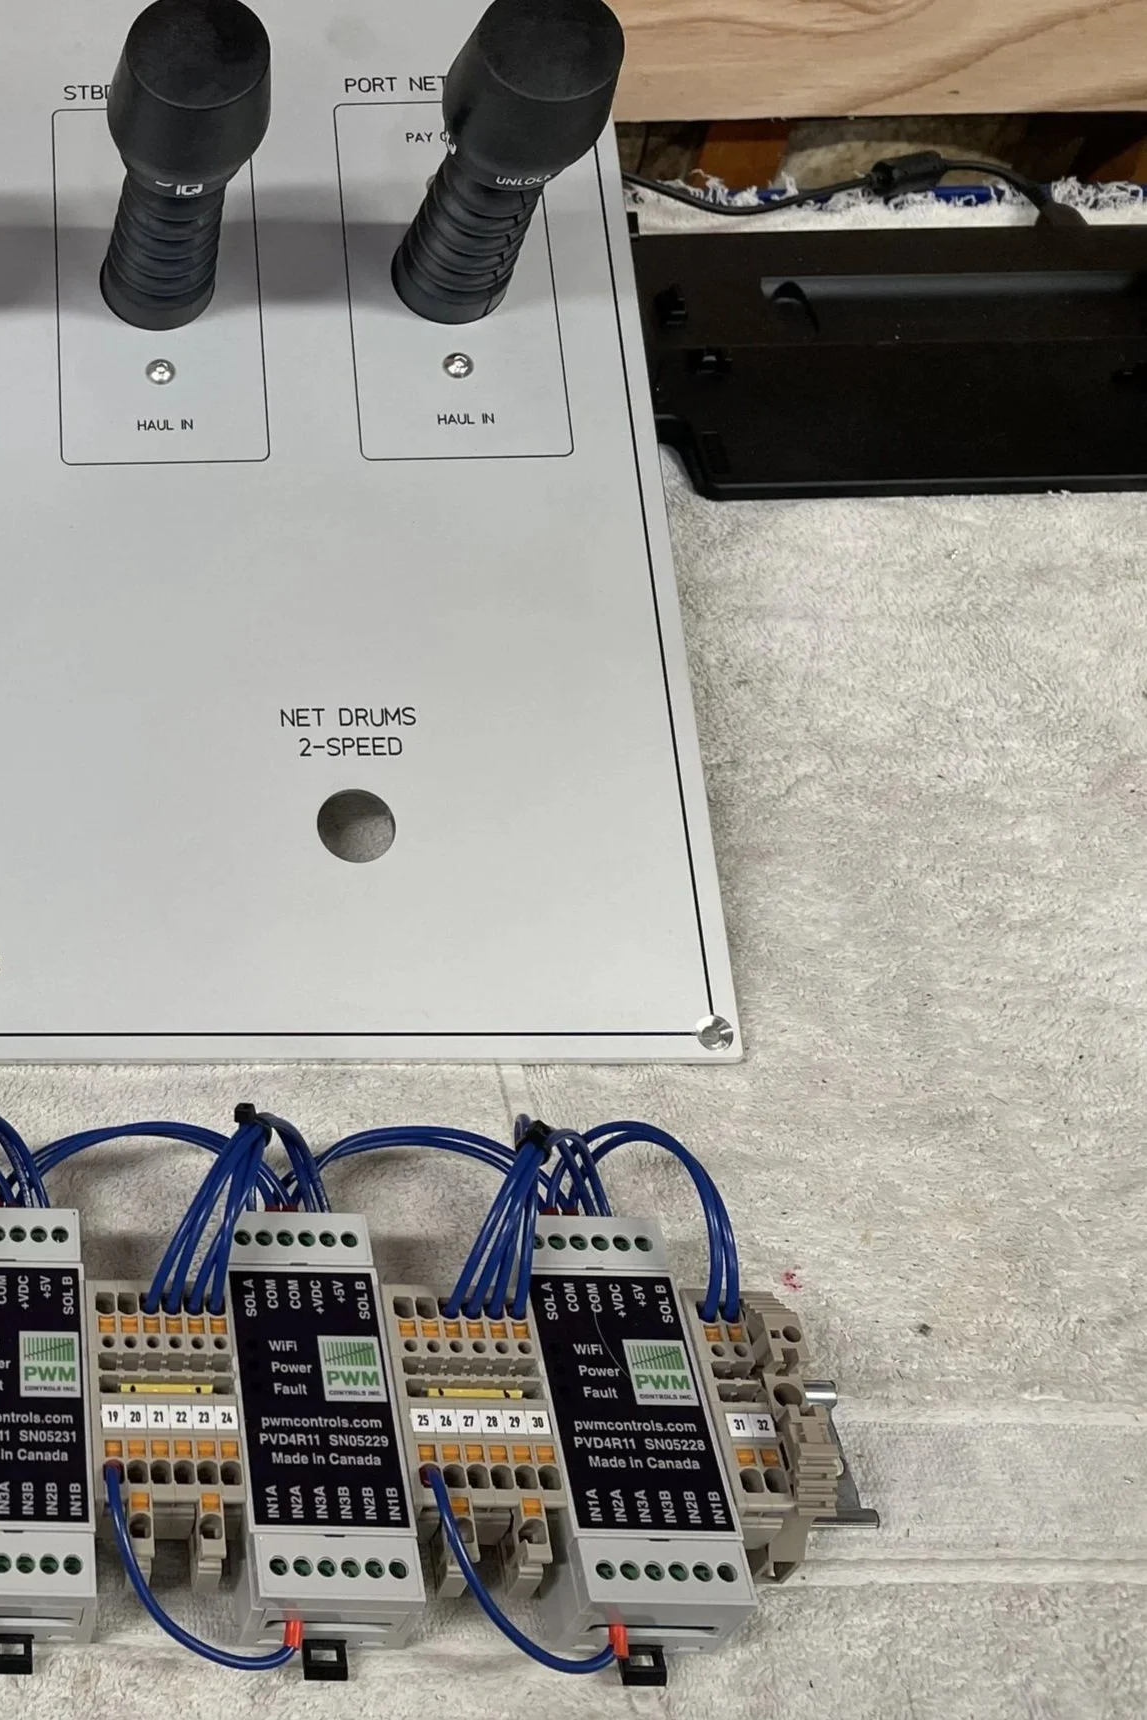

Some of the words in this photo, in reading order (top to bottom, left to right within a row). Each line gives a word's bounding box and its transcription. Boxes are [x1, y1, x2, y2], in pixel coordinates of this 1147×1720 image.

[344, 77, 397, 93] PORT
[406, 132, 433, 143] PAY
[175, 184, 203, 196] IQ
[137, 419, 174, 431] HAUL
[181, 419, 194, 431] IN
[437, 413, 475, 425] HAUL
[482, 413, 495, 425] IN
[280, 708, 325, 727] NET
[339, 707, 417, 727] DRUMS
[299, 737, 403, 757] 2-SPEED
[17, 1275, 30, 1310] +VDC
[265, 1279, 279, 1309] COM
[309, 1280, 325, 1314] +VDC
[563, 1283, 580, 1312] COM
[609, 1283, 627, 1318] +VDC
[268, 1340, 298, 1352] WiFi
[573, 1343, 604, 1356] WiFi
[24, 1366, 76, 1382] PWM
[271, 1361, 313, 1374] Power
[578, 1365, 620, 1377] Power
[326, 1371, 380, 1386] PWM
[634, 1374, 691, 1390] PWM
[273, 1383, 308, 1396] Fault
[582, 1386, 619, 1400] Fault
[108, 1411, 118, 1422] 19
[130, 1411, 141, 1423] 20
[153, 1411, 164, 1423] 21
[175, 1411, 187, 1423] 22
[198, 1412, 210, 1423] 23
[221, 1412, 233, 1424] 24
[261, 1416, 383, 1429] pwmcontrols.com
[417, 1415, 429, 1426] 25
[440, 1415, 452, 1427] 26
[463, 1415, 474, 1427] 27
[486, 1416, 498, 1428] 28
[509, 1416, 521, 1428] 29
[532, 1416, 544, 1428] 30
[573, 1419, 698, 1433] pwmcontrols.com
[733, 1419, 746, 1431] 31
[756, 1420, 770, 1431] 32
[19, 1430, 77, 1443] SN05231
[259, 1433, 320, 1446] PVD4R11
[329, 1434, 389, 1447] SN05229
[573, 1436, 637, 1450] PVD4R11
[644, 1438, 706, 1451] SN05228
[17, 1449, 69, 1462] Canada
[271, 1452, 309, 1465] Made
[329, 1453, 382, 1466] Canada
[588, 1455, 627, 1469] Made
[646, 1456, 701, 1470] Canada
[21, 1482, 35, 1515] IN3B
[45, 1482, 59, 1516] IN2B
[69, 1483, 83, 1517] IN1B
[265, 1485, 280, 1518] IN1A
[289, 1485, 305, 1519] IN2A
[313, 1486, 329, 1519] IN3A
[337, 1486, 353, 1520] IN3B
[361, 1487, 378, 1520] IN2B
[385, 1487, 402, 1521] IN1B
[585, 1488, 603, 1522] IN1A
[609, 1489, 628, 1522] IN2A
[634, 1489, 653, 1523] IN3A
[659, 1490, 678, 1524] IN3B
[683, 1491, 702, 1524] IN2B
[708, 1491, 727, 1525] IN1B
